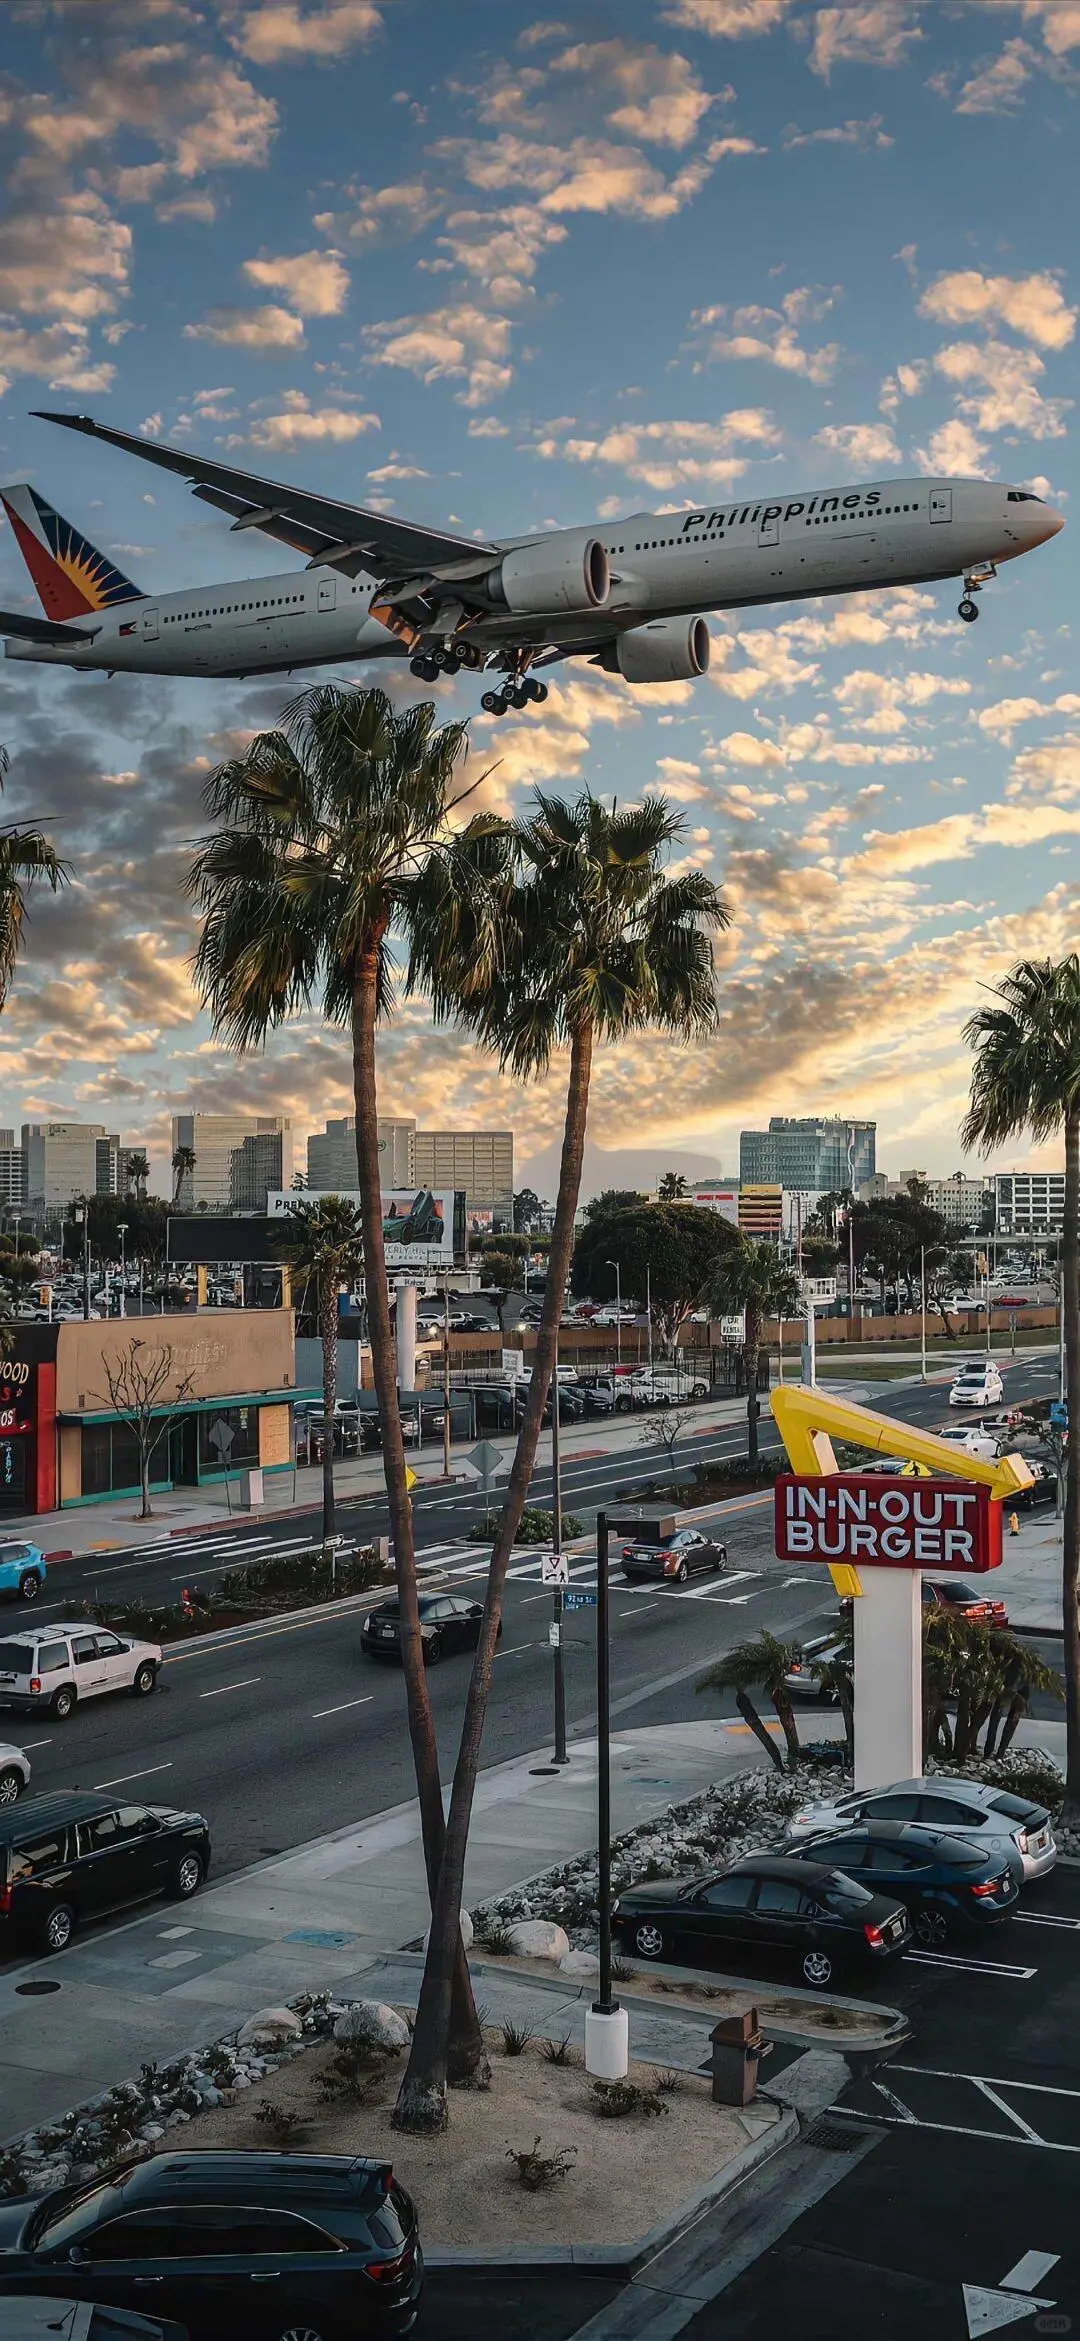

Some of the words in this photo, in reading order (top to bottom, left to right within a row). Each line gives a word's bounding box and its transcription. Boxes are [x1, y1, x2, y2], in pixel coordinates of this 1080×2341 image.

[682, 490, 882, 532] Philippines
[786, 1486, 977, 1526] IN-N-OUT
[786, 1520, 974, 1563] BURGER
